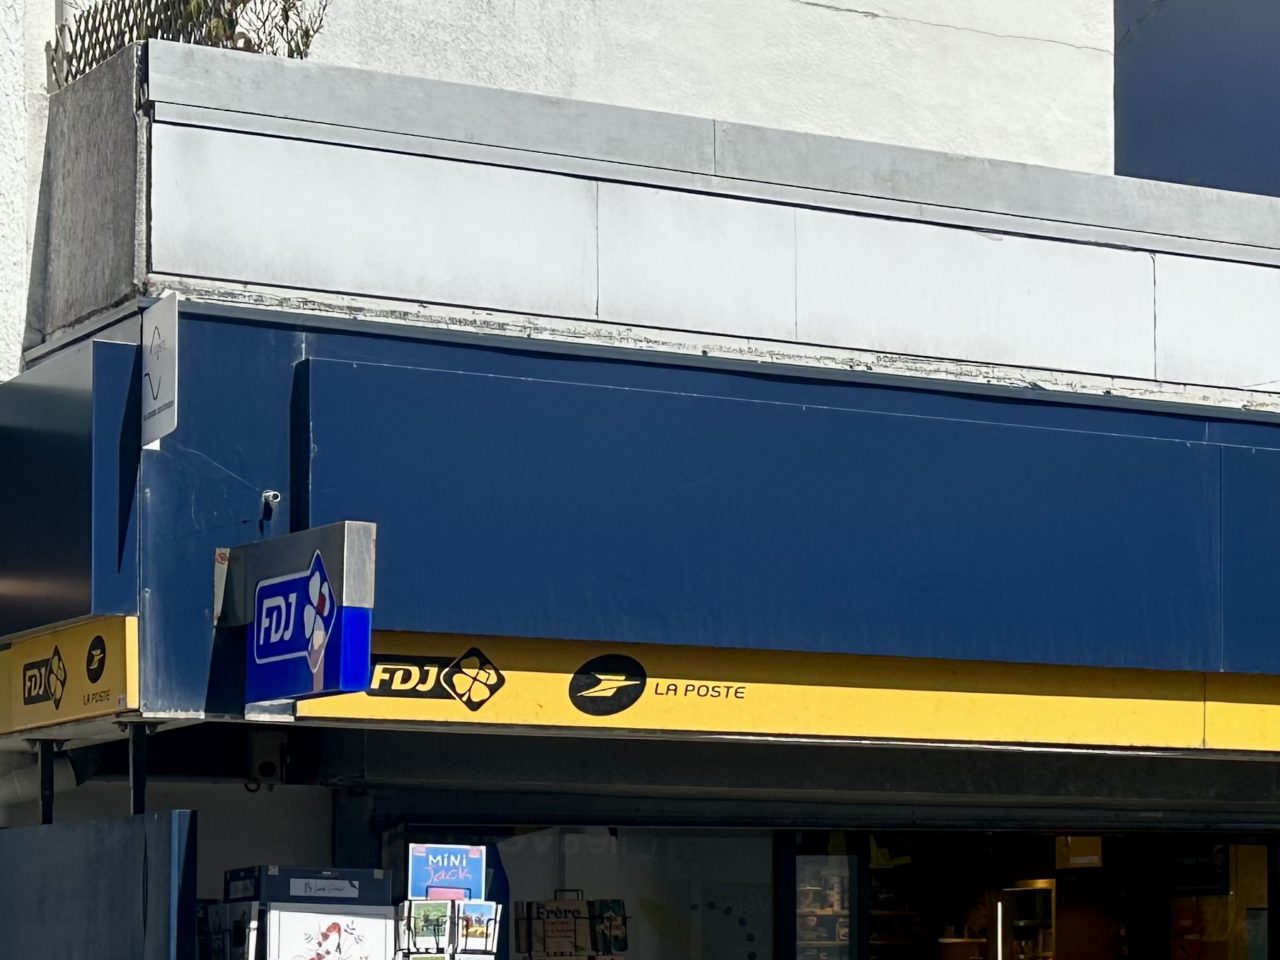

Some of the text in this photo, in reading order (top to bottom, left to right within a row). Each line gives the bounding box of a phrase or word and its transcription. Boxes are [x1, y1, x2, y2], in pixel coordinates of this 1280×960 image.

[259, 592, 297, 645] FDJ
[25, 667, 46, 698] FDJ
[370, 662, 440, 692] FDJ
[655, 682, 746, 699] LA POSTE
